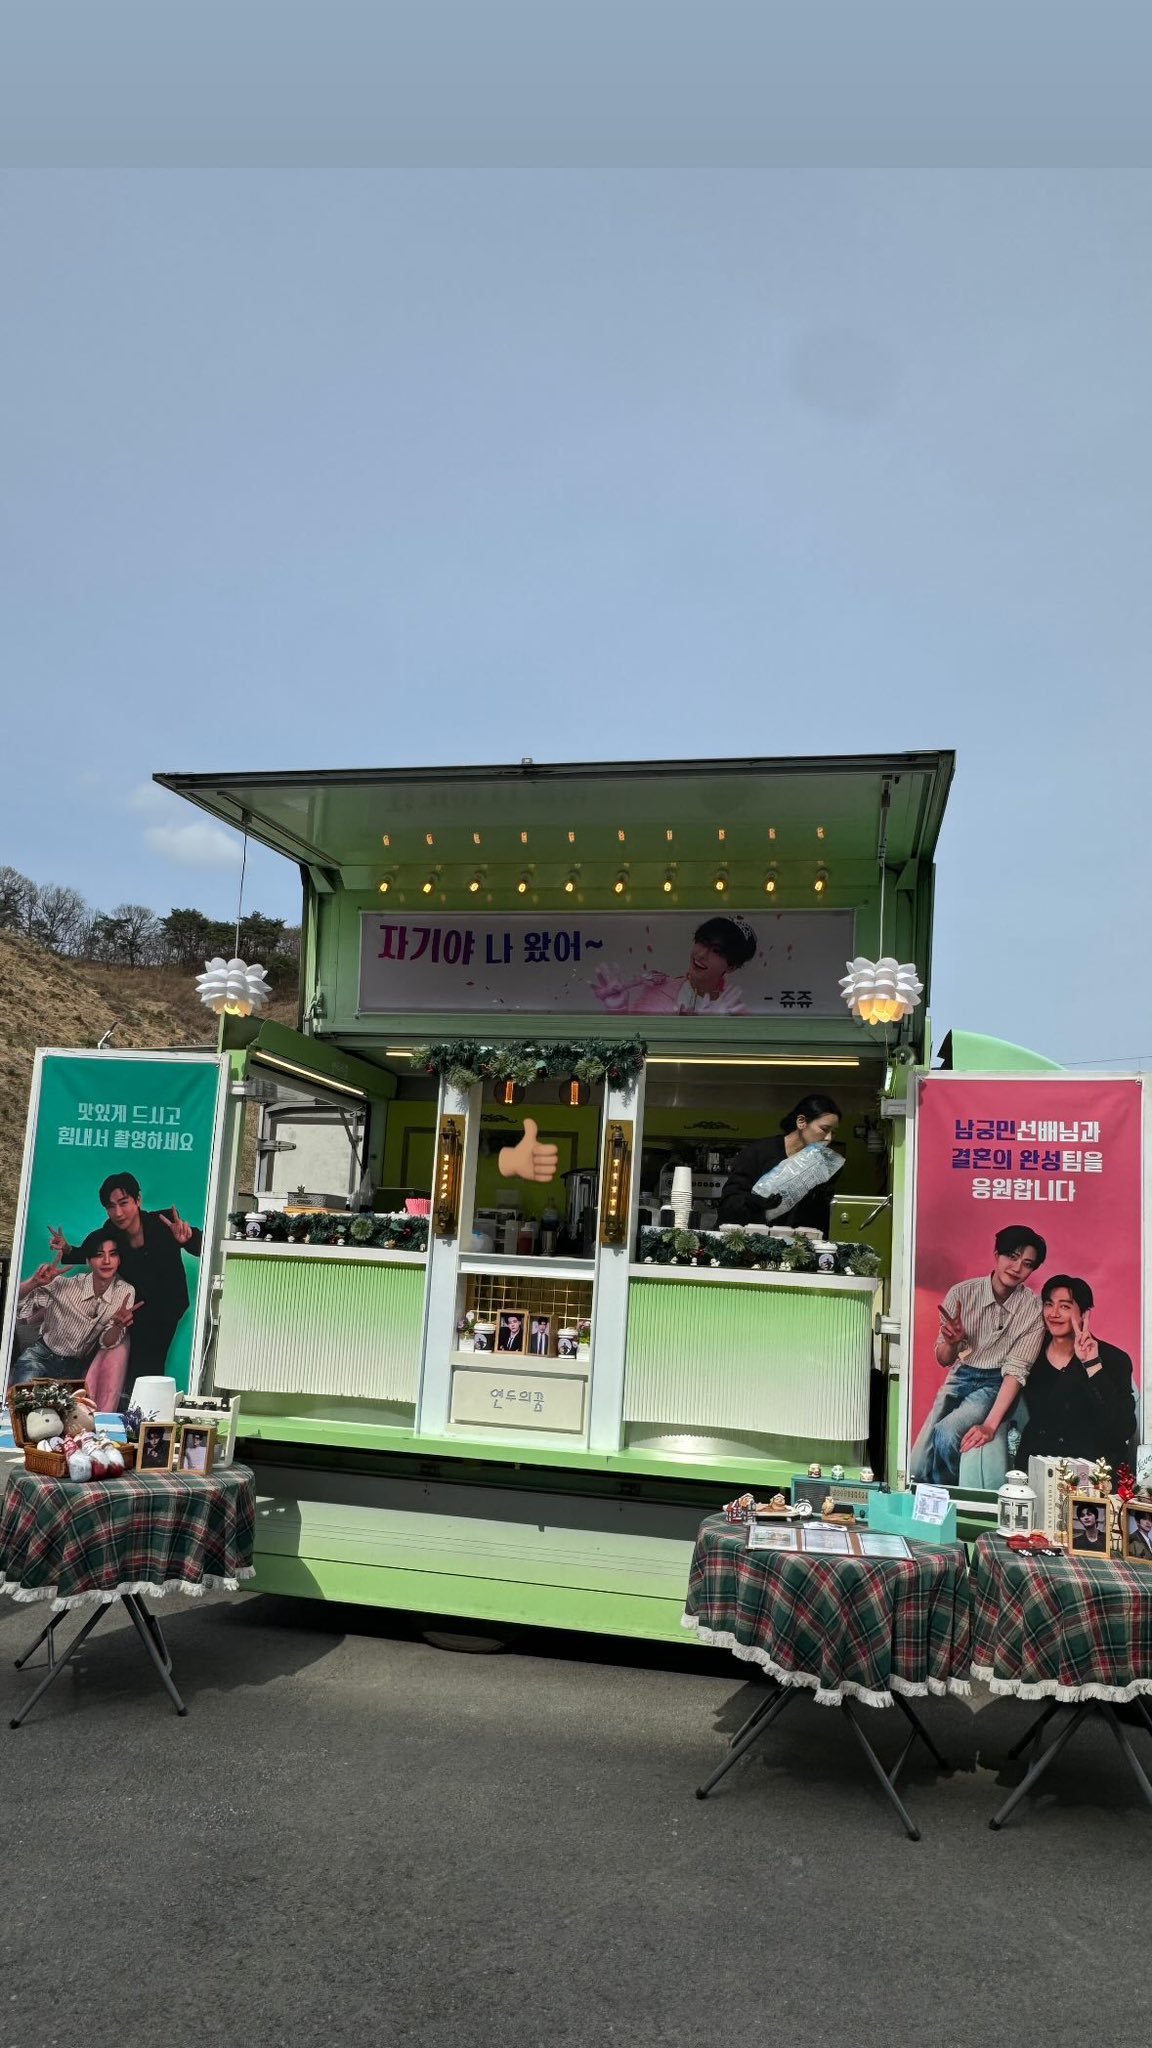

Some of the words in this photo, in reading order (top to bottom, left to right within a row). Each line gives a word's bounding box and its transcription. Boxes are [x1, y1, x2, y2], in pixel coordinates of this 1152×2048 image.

[378, 924, 475, 966] 자기야
[486, 932, 514, 964] 나
[523, 930, 603, 964] 왔어~
[780, 990, 813, 1009] 쥬쥬
[77, 1102, 127, 1123] 맛있게
[131, 1105, 181, 1125] 드시고
[58, 1126, 109, 1148] 힘내서
[113, 1129, 194, 1151] 촬영하세요
[955, 1119, 1100, 1143] 남궁민선배님과
[952, 1148, 1012, 1170] 결혼의
[1019, 1150, 1103, 1173] 완성팀을
[971, 1177, 1076, 1202] 응원합니다
